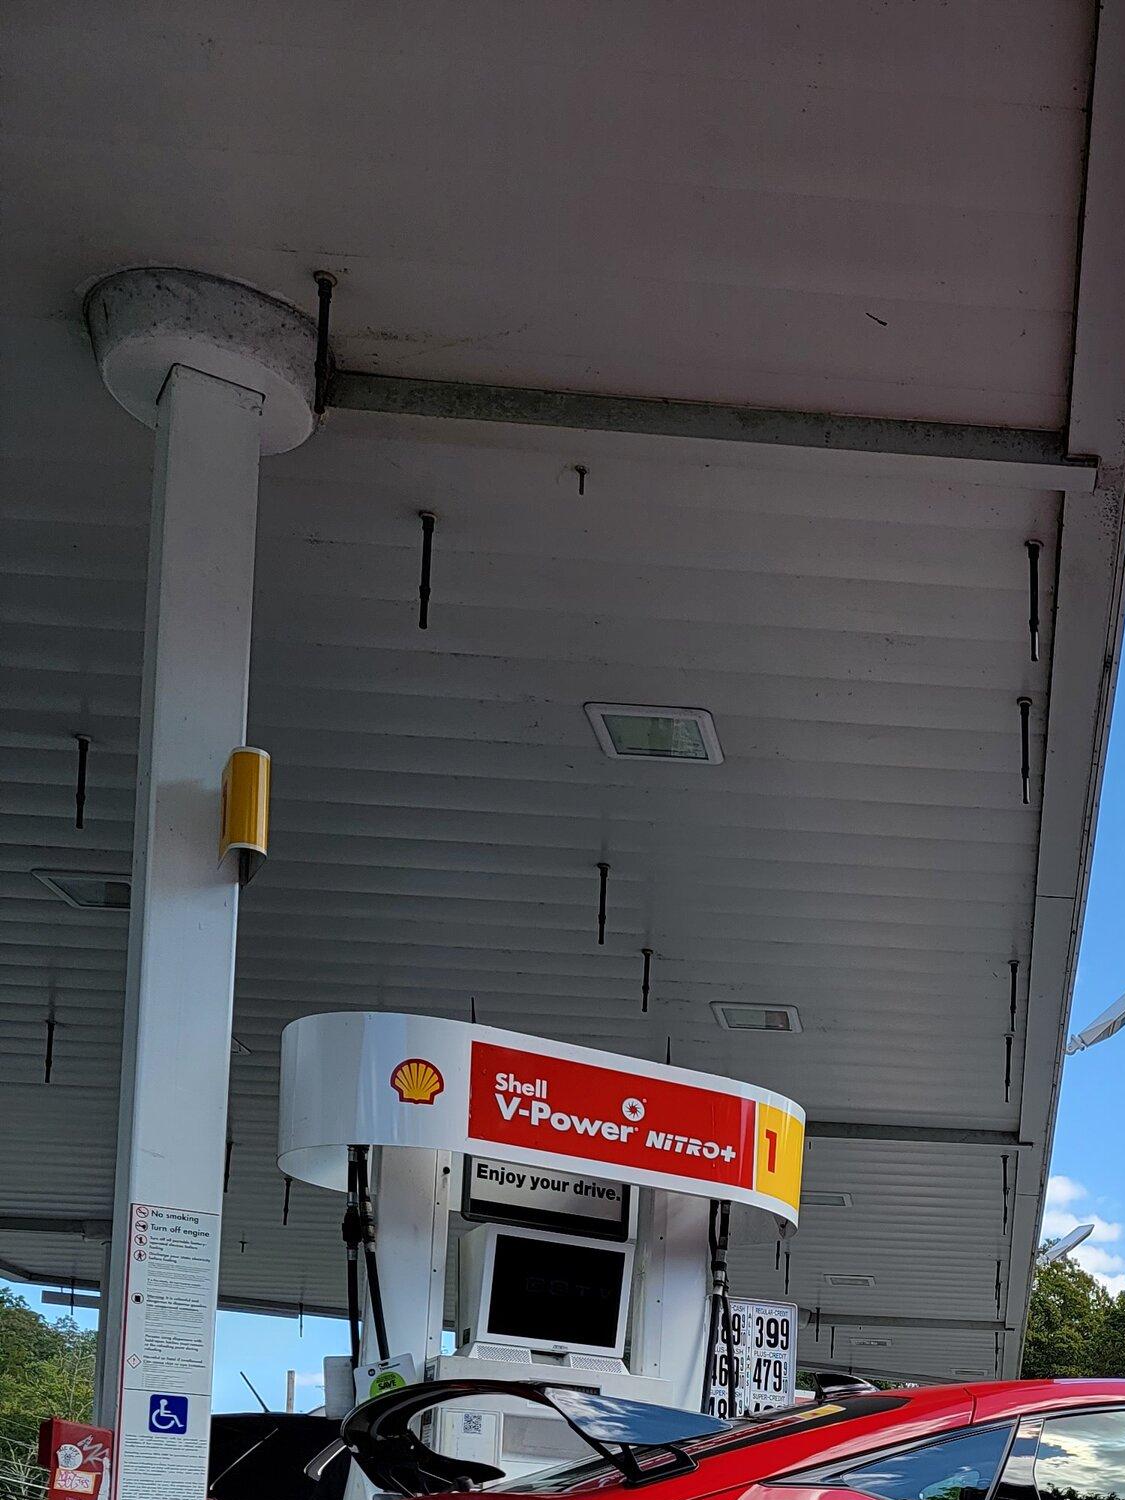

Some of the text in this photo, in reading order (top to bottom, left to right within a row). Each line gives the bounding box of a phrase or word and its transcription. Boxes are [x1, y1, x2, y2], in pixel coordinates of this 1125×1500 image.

[495, 1072, 548, 1099] Shell
[494, 1093, 634, 1143] V-Power
[765, 1129, 777, 1174] 1
[476, 1163, 621, 1201] Enjoy your drive.
[151, 1210, 199, 1224] No smoking
[151, 1224, 167, 1232] Turn
[183, 1229, 210, 1237] engine
[755, 1316, 789, 1350] 399
[753, 1358, 782, 1392] 479
